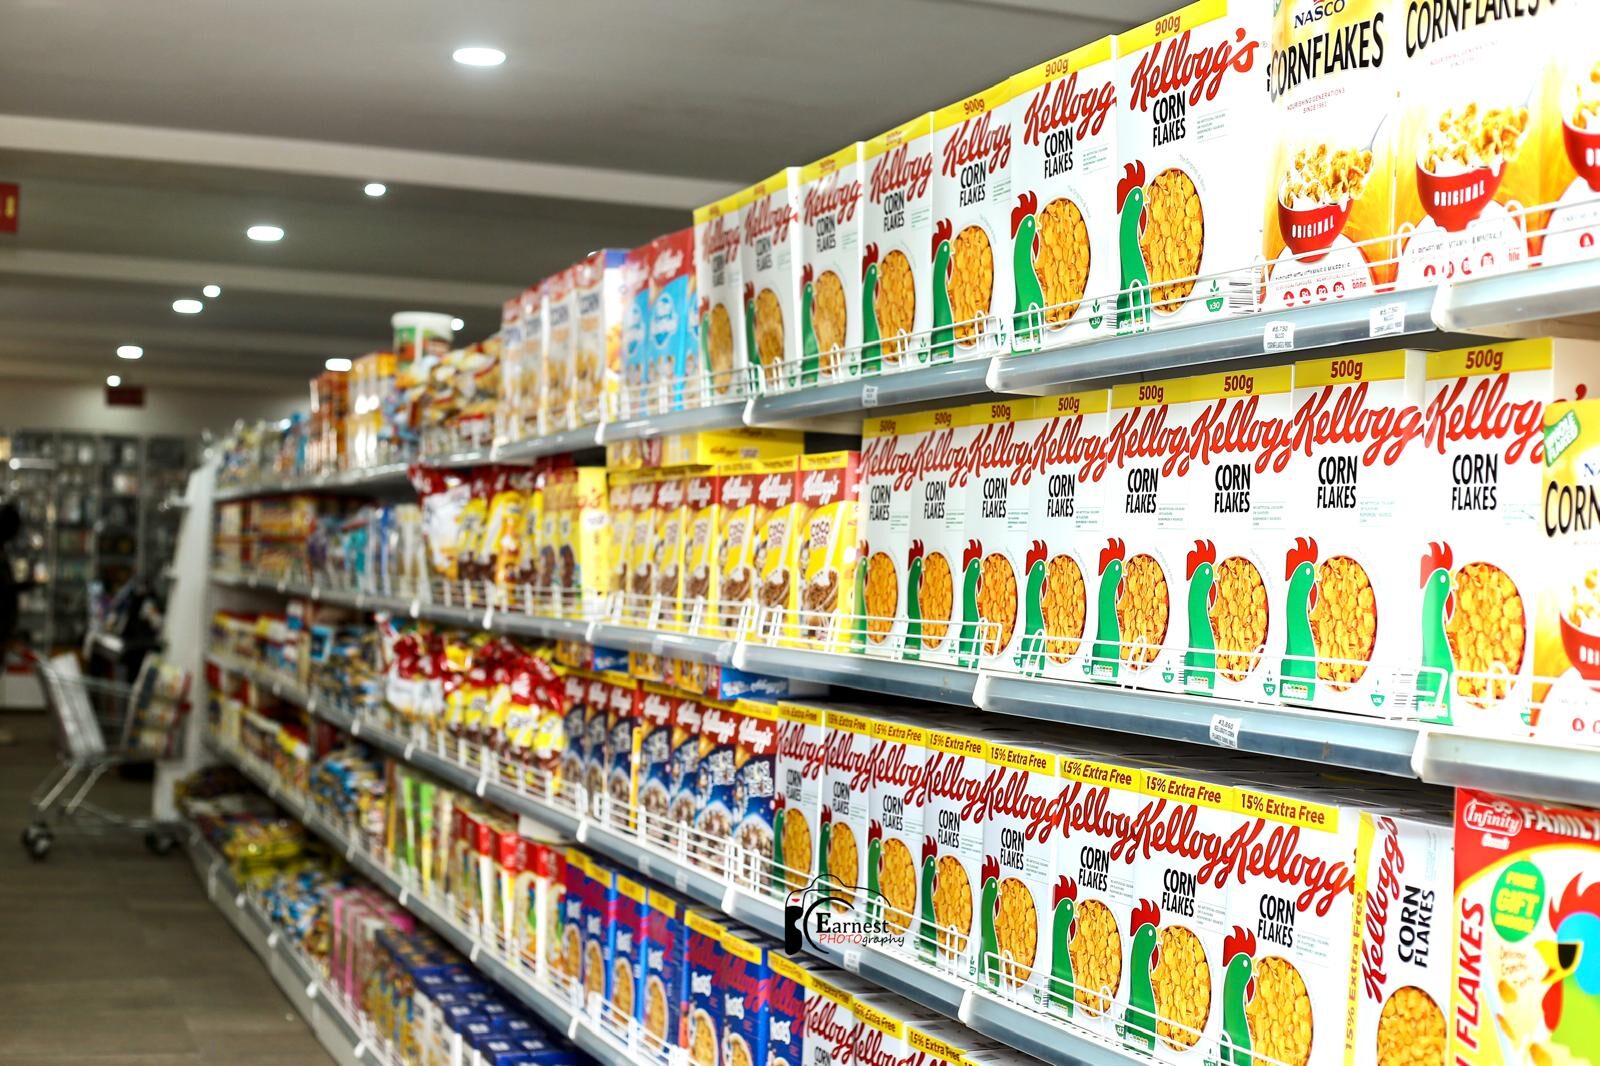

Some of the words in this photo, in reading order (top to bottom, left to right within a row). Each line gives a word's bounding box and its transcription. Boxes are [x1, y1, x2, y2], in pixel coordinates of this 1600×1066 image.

[1155, 15, 1181, 36] 900g
[1294, 0, 1345, 29] NASCO
[1045, 58, 1069, 78] 900g
[1130, 27, 1259, 113] Kellogg's
[1271, 12, 1384, 104] CORNFLAKES
[964, 97, 985, 116] 900g
[1153, 90, 1186, 126] CORN
[1044, 126, 1073, 158] CORN
[1153, 117, 1186, 148] FLAKES
[960, 161, 987, 189] CORN
[1044, 151, 1073, 179] FLAKES
[884, 190, 905, 215] CORN
[959, 181, 986, 207] FLAKES
[1434, 180, 1485, 207] ORIGINAL
[884, 210, 905, 232] FLAKES
[1291, 215, 1335, 239] ORIGINAL
[1331, 360, 1363, 380] 500g
[1465, 349, 1503, 371] 500g
[1139, 385, 1164, 402] 500g
[1224, 375, 1254, 394] 500g
[992, 405, 1011, 420] 500g
[1058, 397, 1079, 414] 500g
[880, 420, 896, 433] 500g
[935, 412, 952, 427] 500g
[1127, 467, 1158, 493] CORN
[1215, 464, 1251, 491] CORN
[1318, 455, 1358, 485] CORN
[1453, 453, 1498, 485] CORN
[871, 484, 891, 504] CORN
[925, 481, 946, 501] CORN
[983, 478, 1007, 500] CORN
[1048, 474, 1075, 498] CORN
[1317, 485, 1357, 509] FLAKES
[924, 500, 945, 519] FLAKES
[982, 500, 1006, 518] FLAKES
[1047, 498, 1074, 518] FLAKES
[1126, 493, 1156, 514] FLAKES
[1214, 491, 1250, 513] FLAKES
[1451, 486, 1497, 511] FLAKES
[870, 504, 890, 522] FLAKES
[887, 726, 905, 738] Extra
[907, 729, 922, 741] Free
[929, 733, 944, 746] 15%
[945, 737, 964, 750] Extra
[966, 741, 982, 754] Free
[991, 747, 1006, 761] 15%
[1007, 751, 1028, 765] Extra
[1030, 756, 1047, 769] Free
[1064, 761, 1081, 776] 15%
[1082, 766, 1107, 782] Extra
[1109, 771, 1132, 785] Free
[834, 781, 850, 798] CORN
[1146, 775, 1166, 792] 15%
[1167, 781, 1195, 798] Extra
[1198, 786, 1221, 803] Free
[833, 796, 849, 815] FLAKES
[883, 795, 903, 814] CORN
[1241, 793, 1264, 812] 15%
[1265, 799, 1295, 820] Extra
[1299, 805, 1325, 824] Free
[1467, 799, 1520, 834] Infinity
[882, 814, 903, 831] FLAKES
[939, 809, 960, 831] CORN
[938, 828, 960, 848] FLAKES
[1001, 827, 1024, 850] CORN
[1000, 848, 1024, 871] FLAKES
[1080, 845, 1110, 874] CORN
[1079, 867, 1108, 892] FLAKES
[1163, 868, 1196, 898] CORN
[1162, 891, 1195, 918] FLAKES
[1259, 893, 1296, 926] CORN
[1352, 891, 1364, 940] Free
[1361, 816, 1405, 1004] Kellogg's
[1257, 918, 1293, 948] FLAKES
[1397, 884, 1421, 964] CORN
[1414, 889, 1436, 969] FLAKES
[1348, 942, 1360, 1001] Extra
[1455, 897, 1486, 1050] FLAKES
[865, 1009, 880, 1026] Extra
[881, 1016, 896, 1032] Free
[1344, 1004, 1356, 1050] 15%
[910, 1031, 924, 1046] 15%
[925, 1039, 945, 1056] Extra
[944, 1046, 961, 1061] Free
